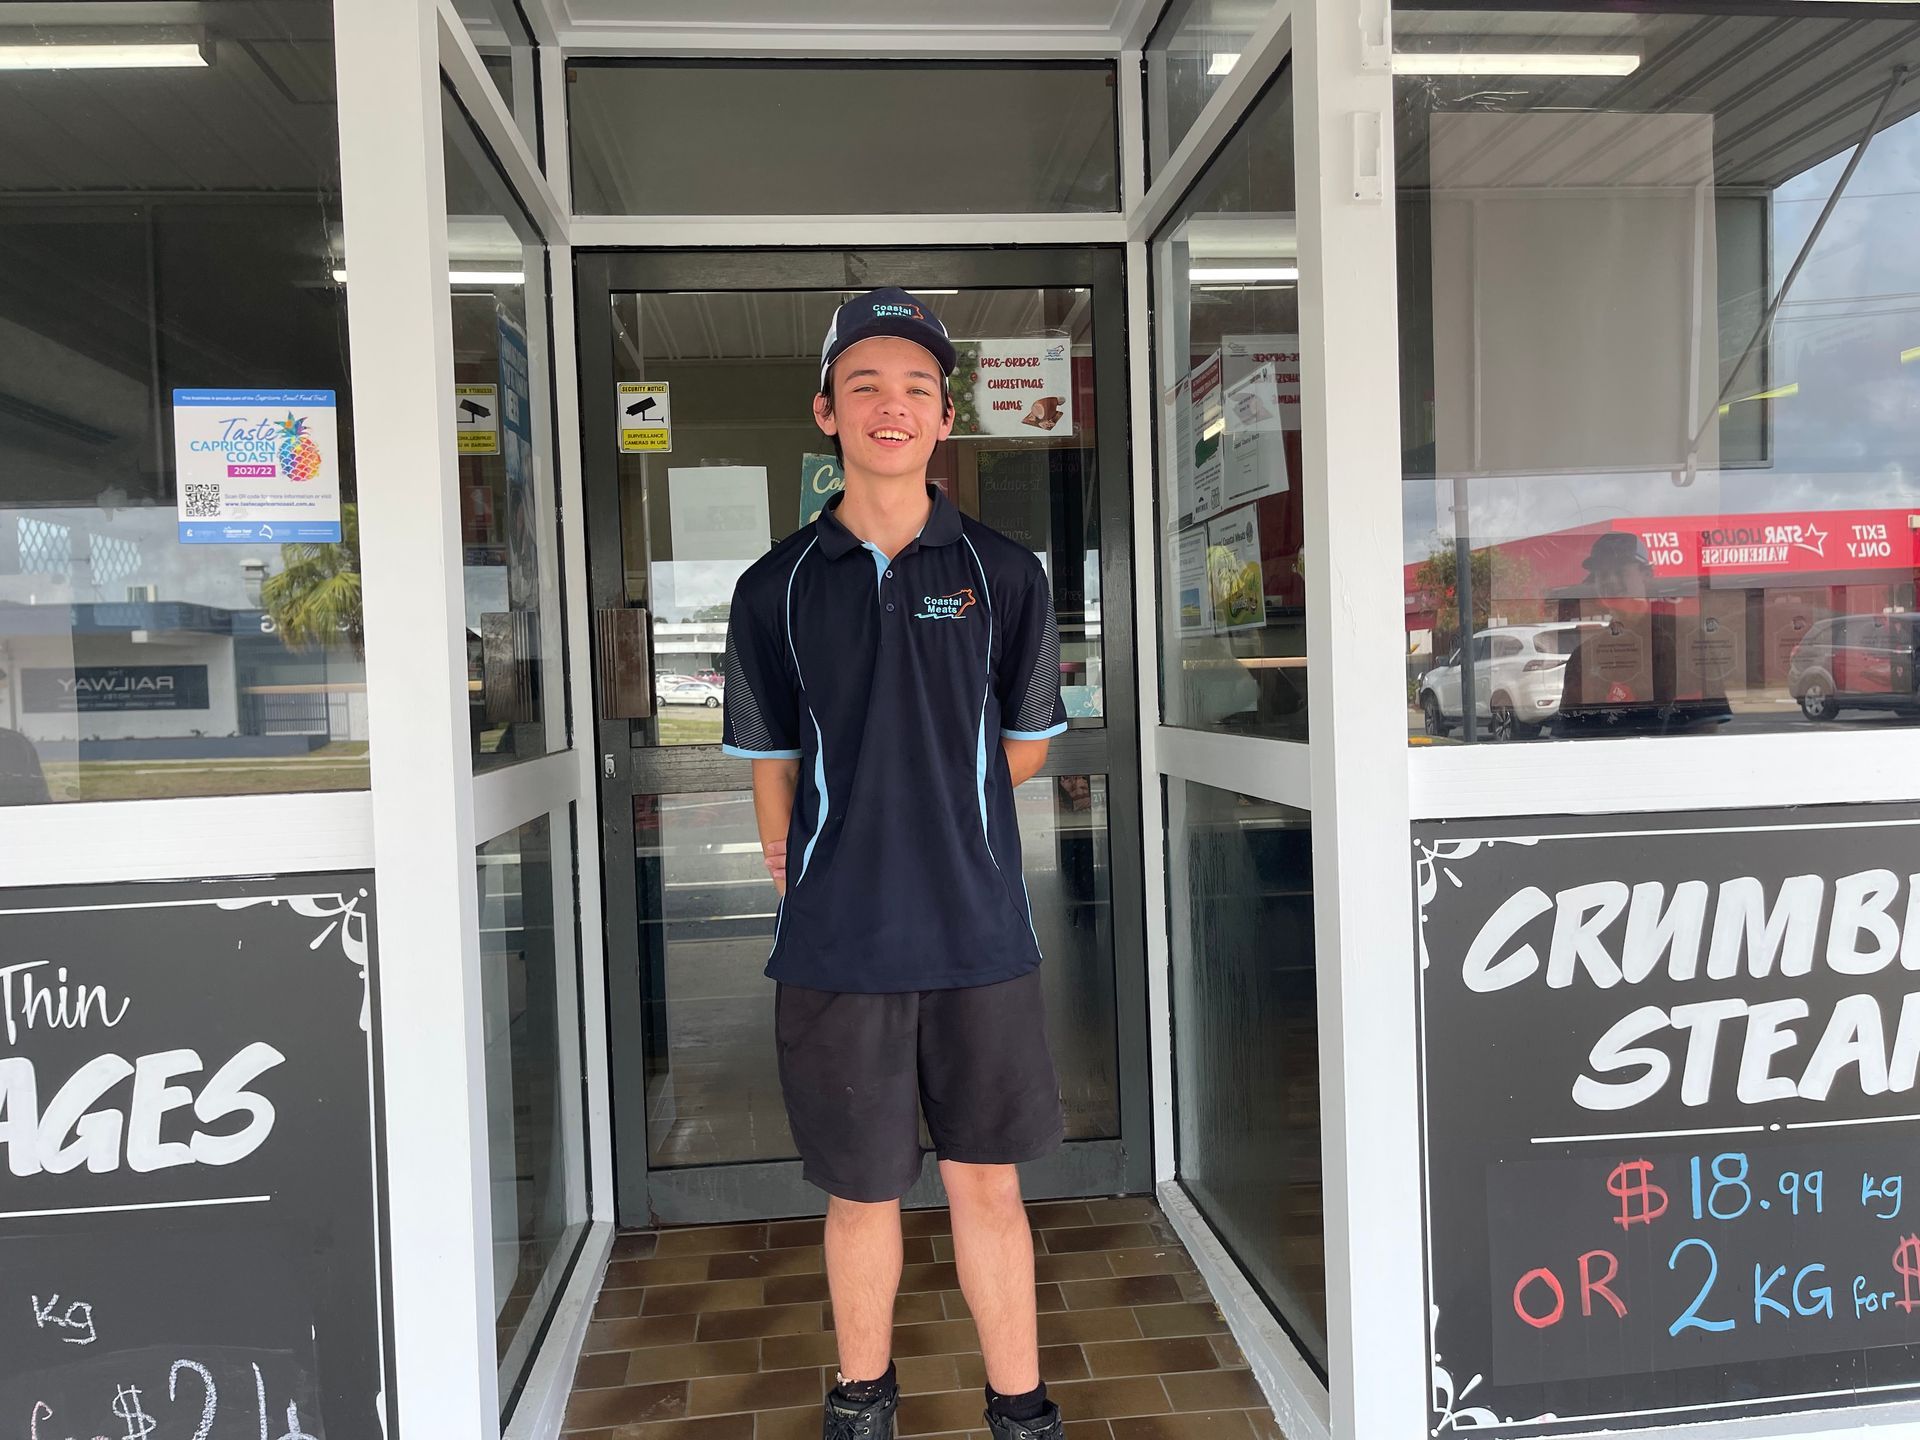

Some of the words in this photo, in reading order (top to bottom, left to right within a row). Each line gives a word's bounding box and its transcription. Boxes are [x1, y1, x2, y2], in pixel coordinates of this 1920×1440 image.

[873, 304, 912, 316] Coastal
[981, 357, 1040, 368] PRE-ORDER
[219, 418, 279, 441] Taste
[190, 440, 276, 452] CAPRICORN
[226, 452, 276, 463] COAST
[234, 466, 273, 475] 2021/22
[924, 596, 962, 606] Coastal
[928, 605, 957, 613] Meats
[0, 960, 130, 1044] Thin
[1513, 1249, 1629, 1329] OR
[1853, 1275, 1896, 1320] for
